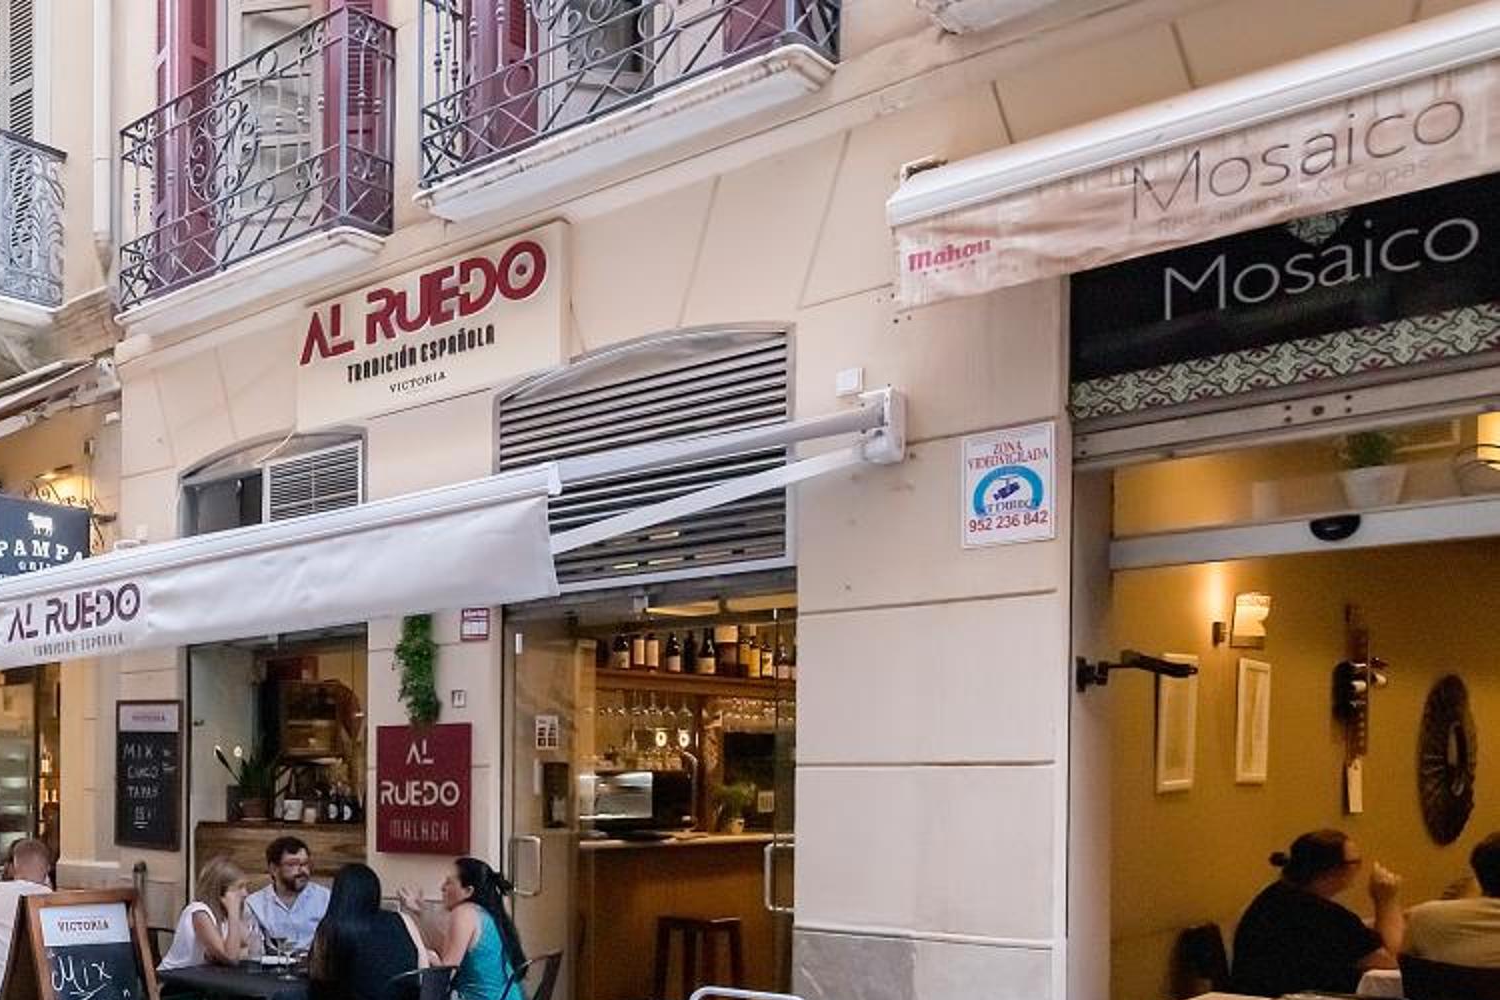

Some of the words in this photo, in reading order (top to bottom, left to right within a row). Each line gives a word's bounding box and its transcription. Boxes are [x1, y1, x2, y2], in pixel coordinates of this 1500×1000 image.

[1132, 99, 1466, 220] Mosaico
[908, 239, 991, 272] Mahou
[1163, 216, 1481, 322] Mosaico
[300, 304, 355, 365] AL
[365, 240, 548, 345] RUEDO
[347, 342, 417, 383] TRADICIÓN
[419, 323, 495, 363] ESPAÑOLA
[389, 371, 447, 393] VICTORIA
[969, 517, 992, 532] 952
[996, 514, 1020, 529] 236
[7, 603, 39, 642] AL
[45, 582, 141, 636] RUEDO
[405, 739, 435, 765] AL
[380, 780, 461, 807] RUEDO
[57, 919, 110, 932] VICTORIA
